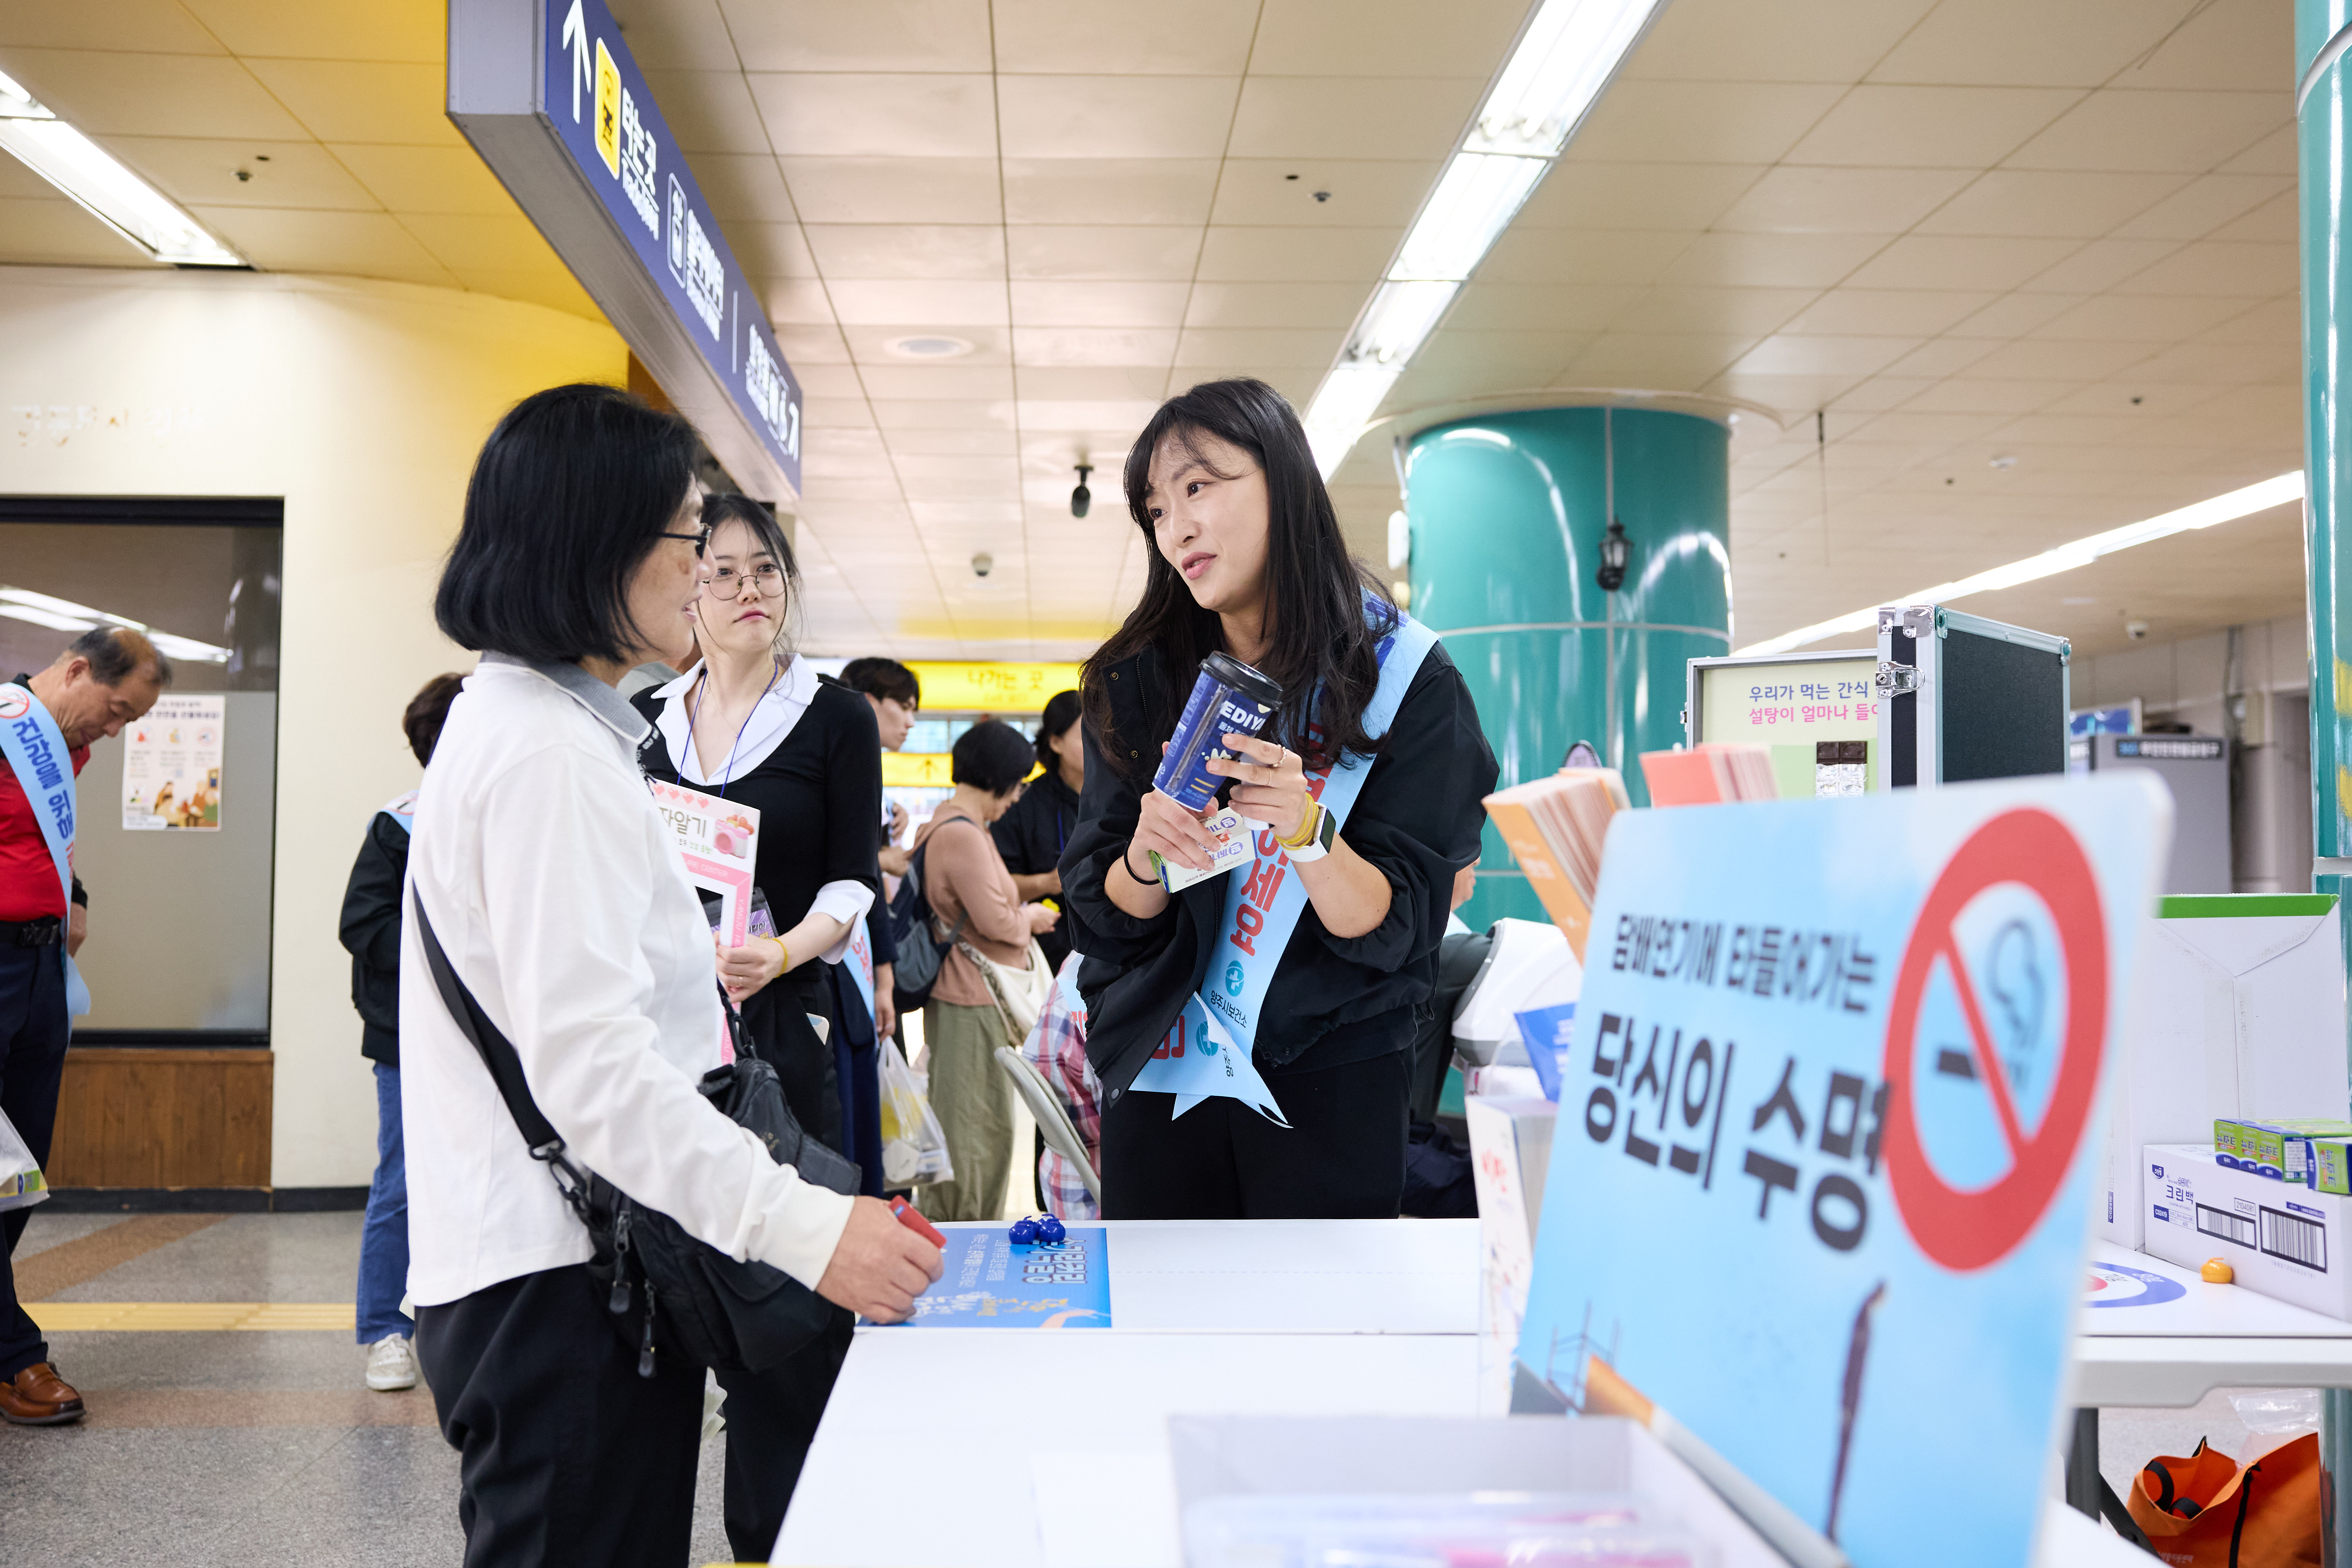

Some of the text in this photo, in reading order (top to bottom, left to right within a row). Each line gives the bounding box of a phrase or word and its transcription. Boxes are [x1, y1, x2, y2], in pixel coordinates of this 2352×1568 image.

[622, 87, 645, 176] 타는
[644, 129, 657, 196] 곳
[968, 669, 1044, 692] 나가는 곳
[1749, 681, 1868, 702] 우리가 먹는 간식
[1219, 700, 1266, 731] EDIYA
[1749, 707, 1794, 724] 설탕이
[1801, 704, 1849, 722] 얼마나
[12, 716, 74, 839] 건강을 위해
[1612, 913, 1877, 1013] 담배연기에 타들어가는
[1211, 990, 1247, 1028] 양주시보건소
[1585, 1012, 1891, 1252] 당신의 수명
[2166, 1184, 2194, 1205] 크린백
